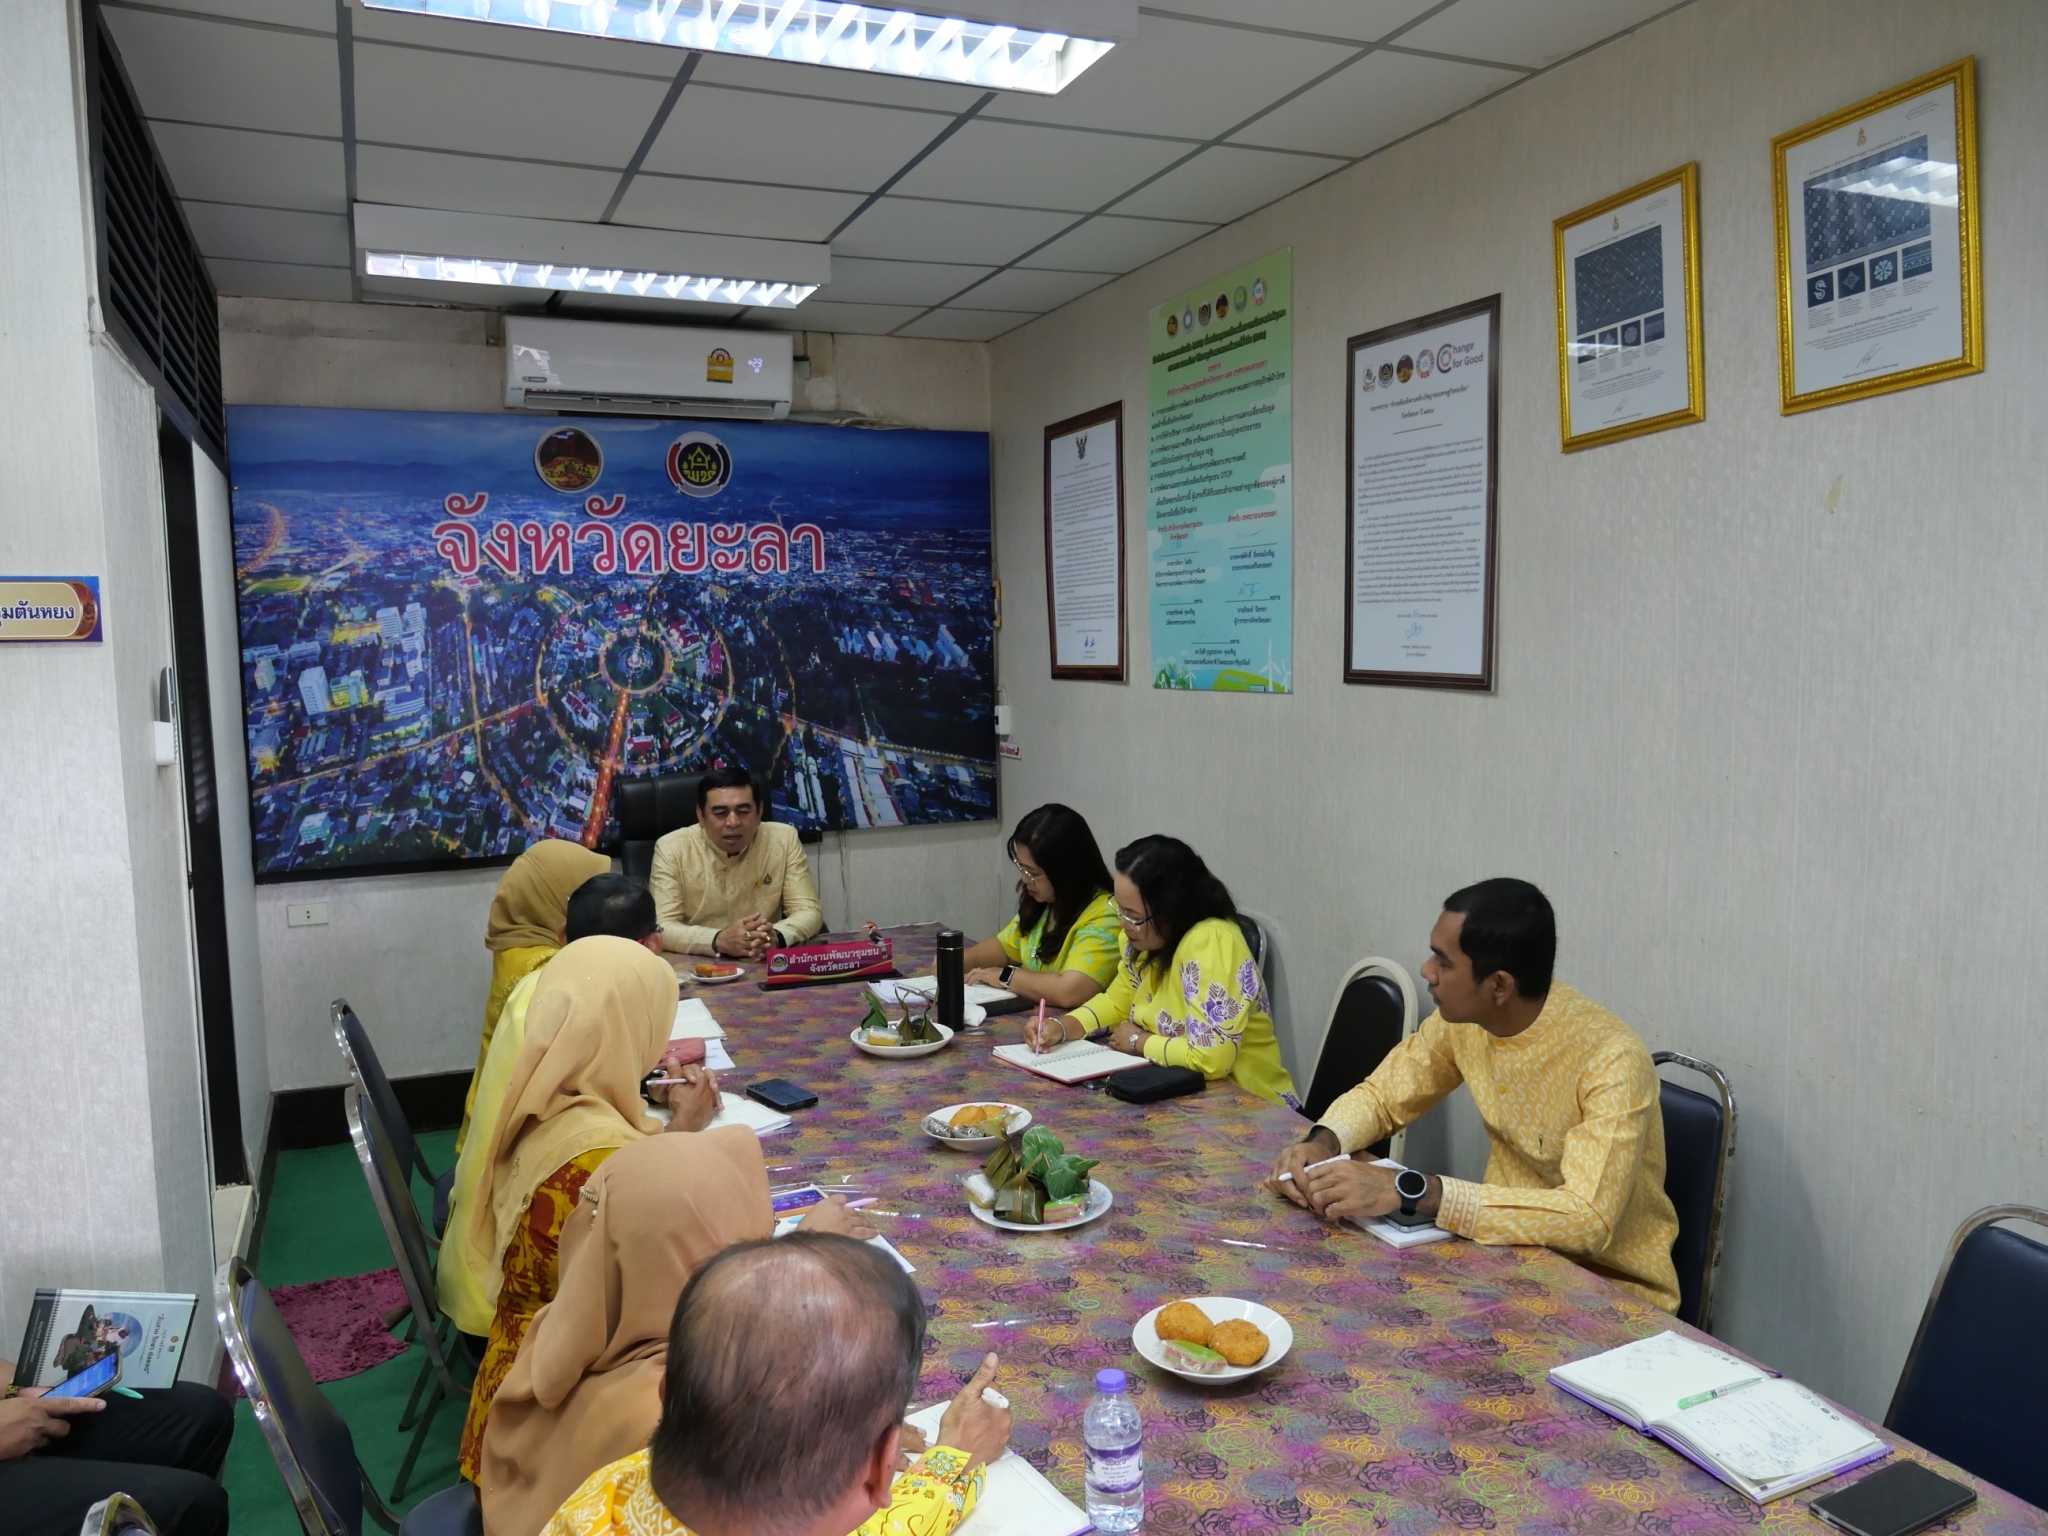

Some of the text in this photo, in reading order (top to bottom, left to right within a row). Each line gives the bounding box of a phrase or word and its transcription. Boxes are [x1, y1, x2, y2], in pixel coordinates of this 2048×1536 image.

[1453, 353, 1484, 369] for Good
[432, 492, 826, 576] จังหวัดยะลา
[0, 600, 75, 626] มตันหยง
[789, 948, 880, 965] สำนักงานพัฒนาชุมชน
[809, 960, 860, 974] จังหวัดยะลา
